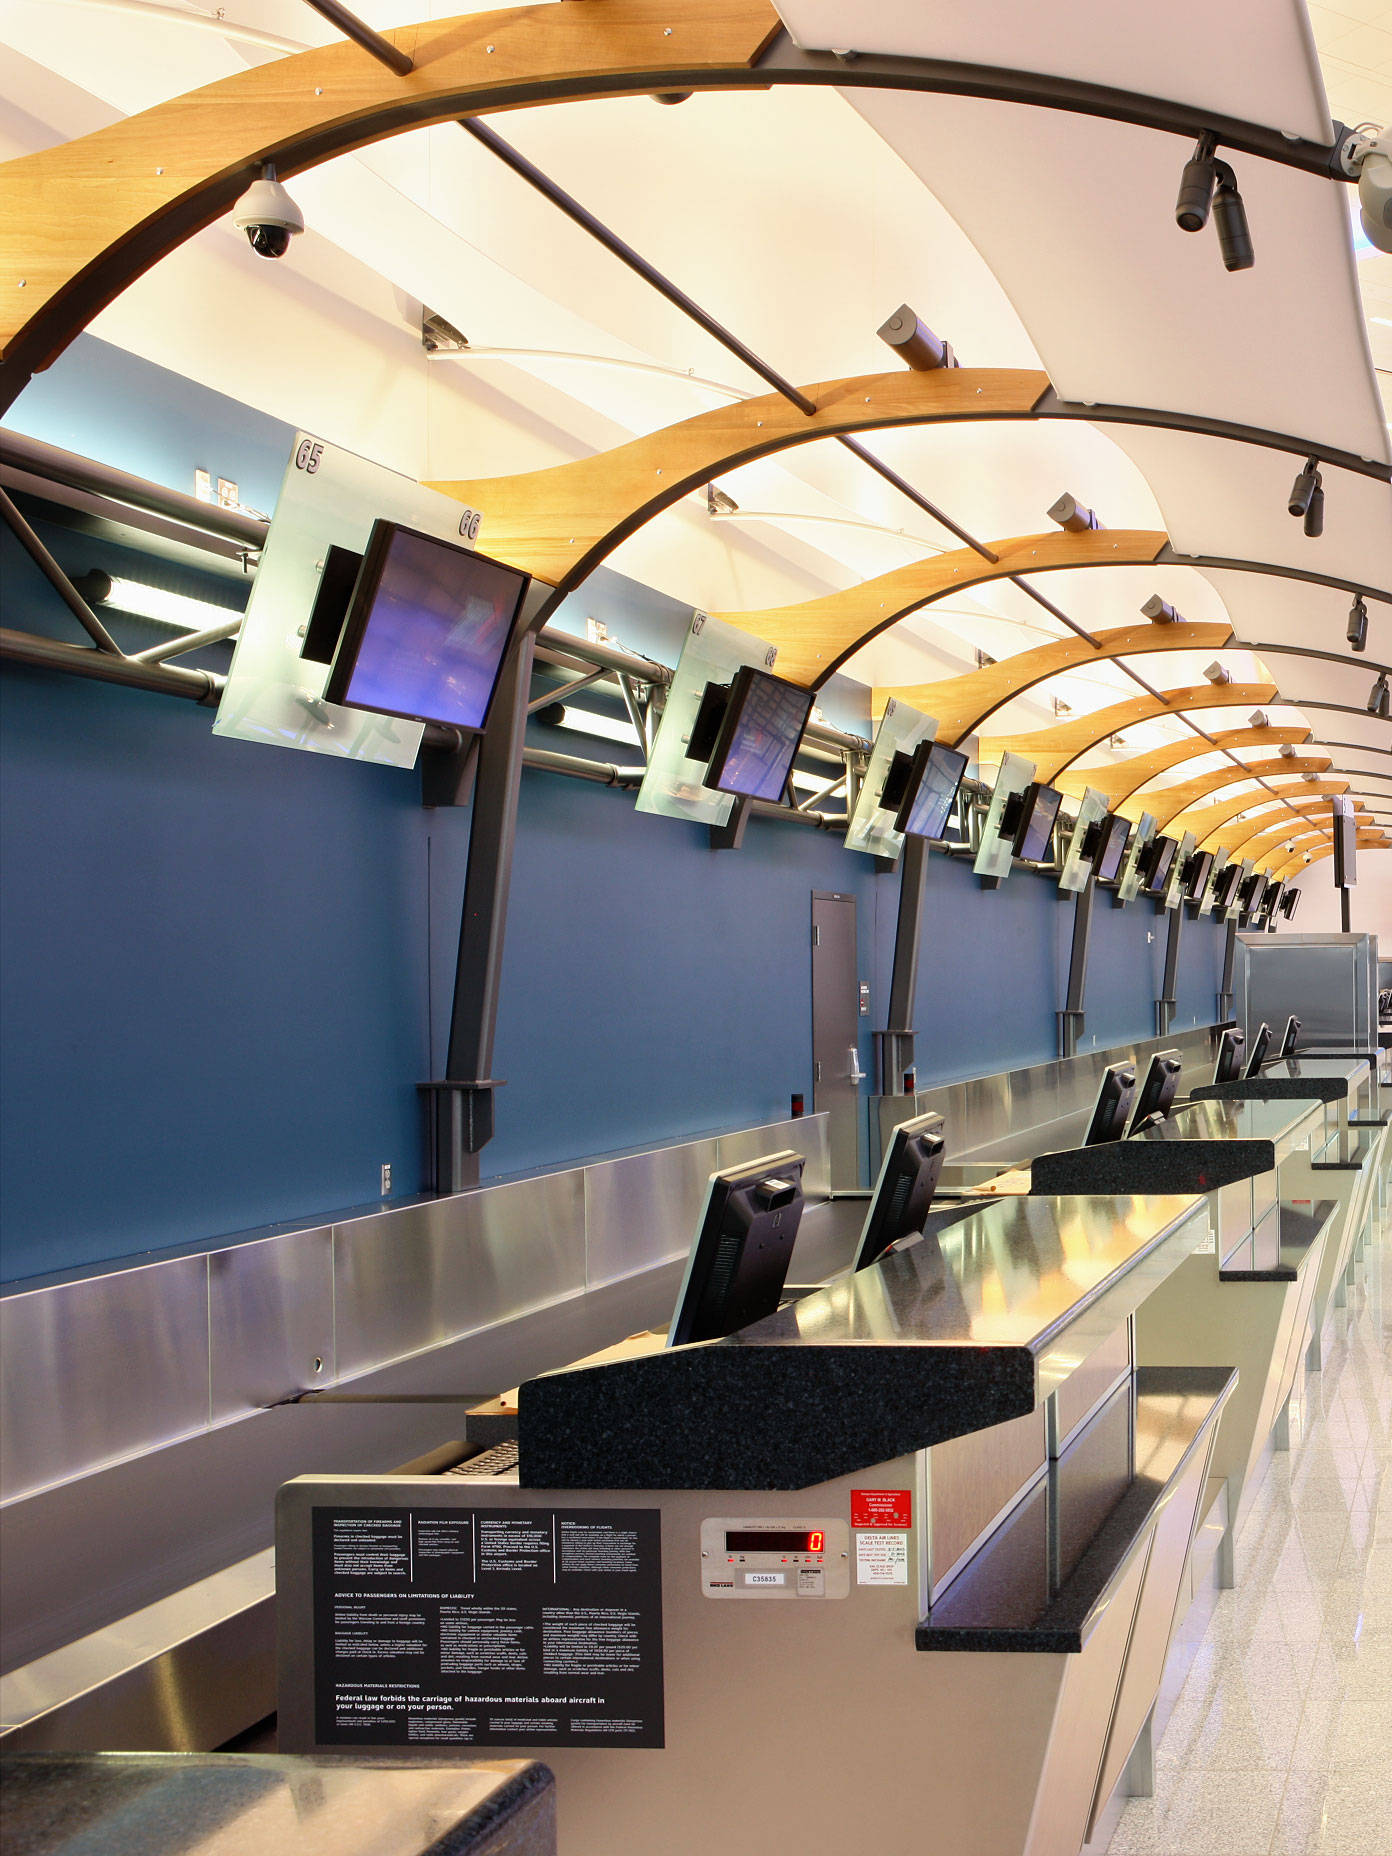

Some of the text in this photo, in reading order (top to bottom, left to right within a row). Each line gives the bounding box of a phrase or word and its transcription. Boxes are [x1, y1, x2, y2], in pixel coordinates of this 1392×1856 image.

[296, 439, 324, 474] 65
[459, 510, 481, 539] 66
[692, 613, 707, 635] 67
[765, 647, 777, 667] 68
[810, 1532, 822, 1551] 0
[752, 1575, 776, 1583] C35835
[354, 1703, 383, 1711] luggage
[422, 1696, 451, 1704] carriage
